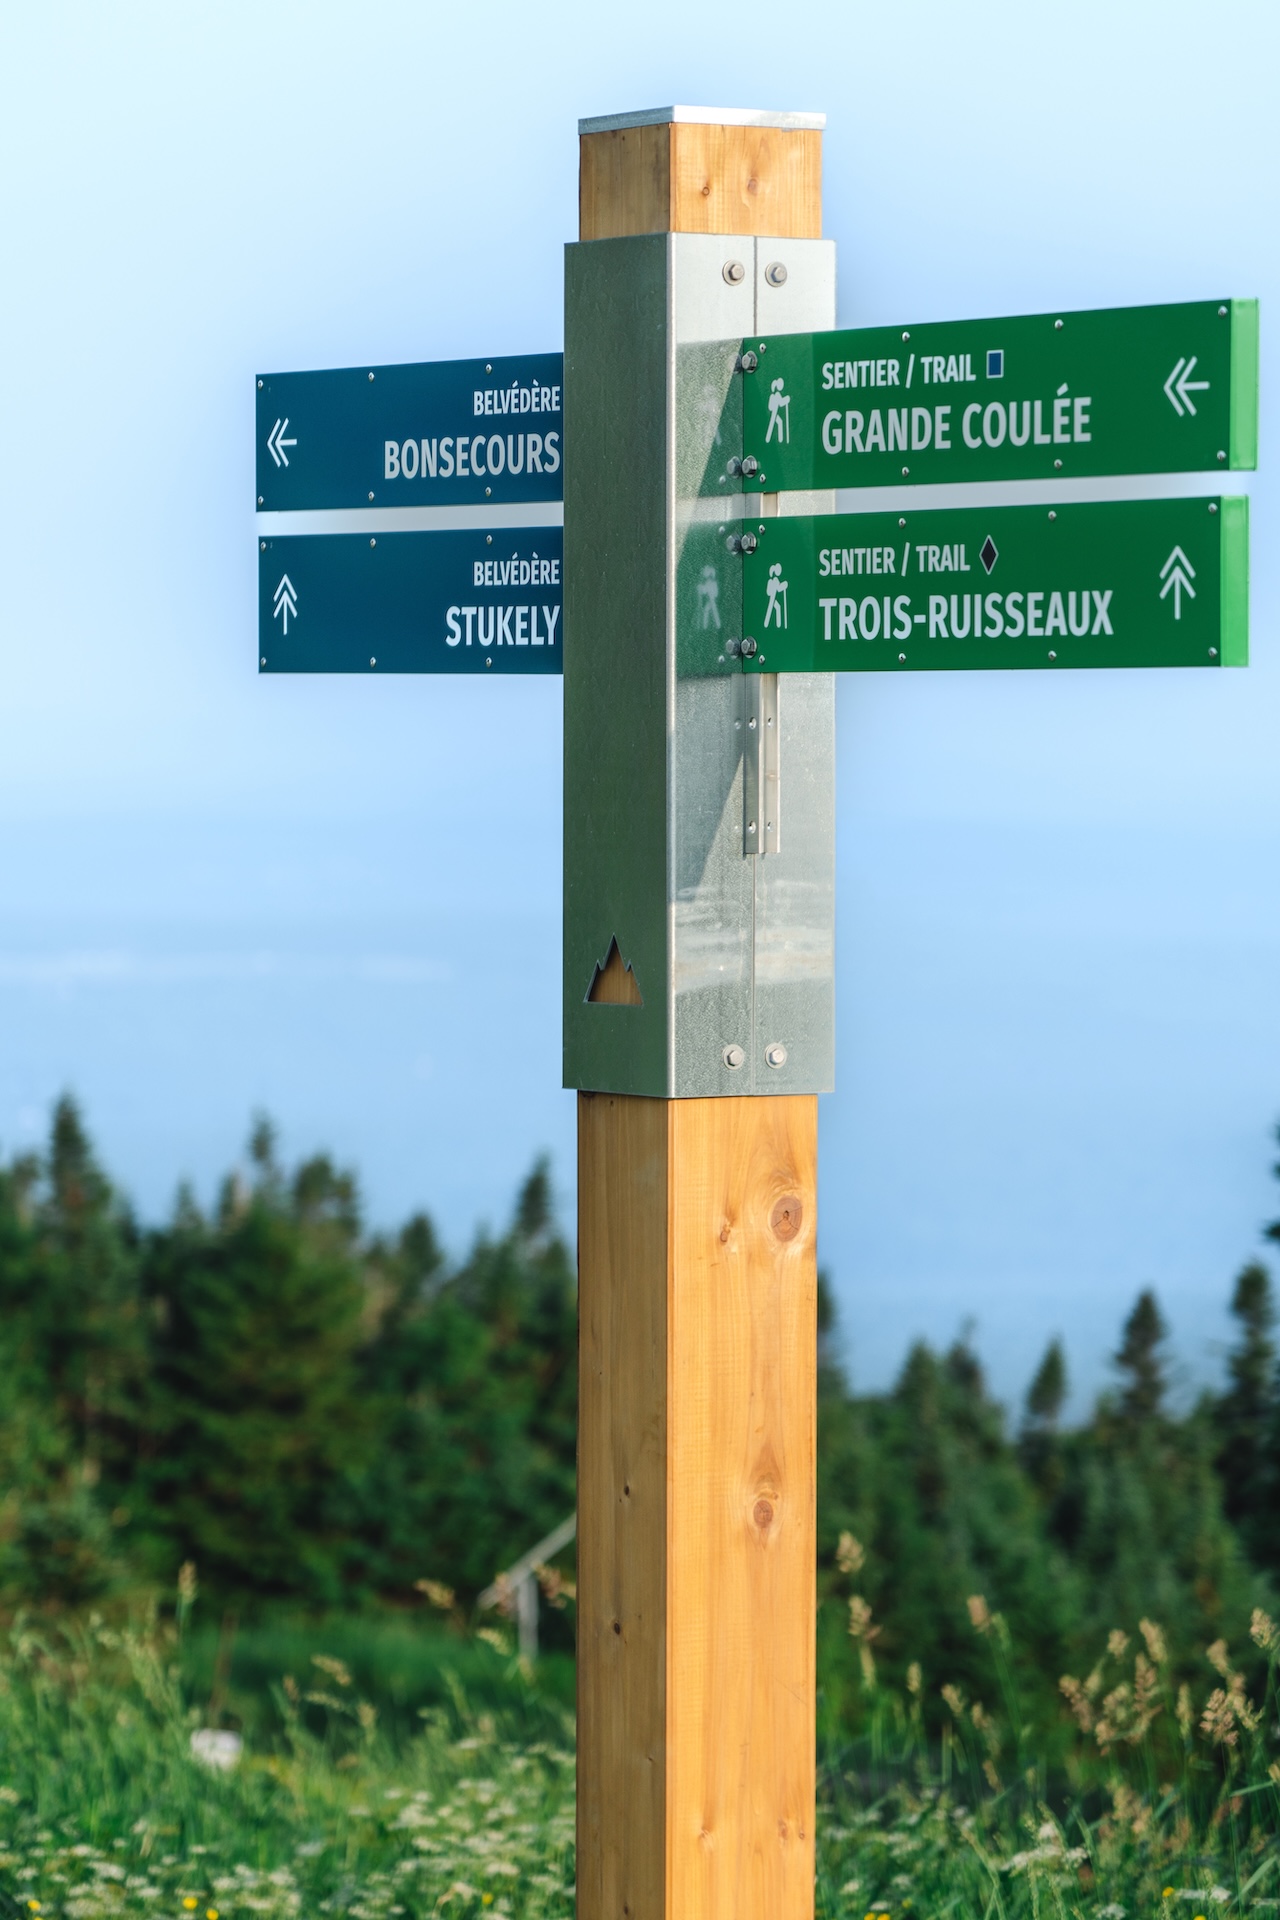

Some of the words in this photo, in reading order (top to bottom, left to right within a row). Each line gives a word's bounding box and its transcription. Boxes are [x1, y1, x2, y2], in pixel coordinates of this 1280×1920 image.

[822, 359, 900, 390] SENTIER
[906, 354, 915, 388] /
[921, 354, 976, 383] TRAIL
[474, 379, 560, 415] BELVÉDÈRE
[822, 406, 951, 454] GRANDE
[962, 383, 1091, 448] COULÉE
[385, 432, 560, 479] BONSECOURS
[474, 552, 559, 586] BELVÉDÈRE
[819, 547, 895, 576] SENTIER
[901, 542, 910, 576] /
[916, 544, 970, 572] TRAIL
[446, 606, 560, 646] STUKELY
[819, 590, 1113, 640] TROIS-RUISSEAUX
